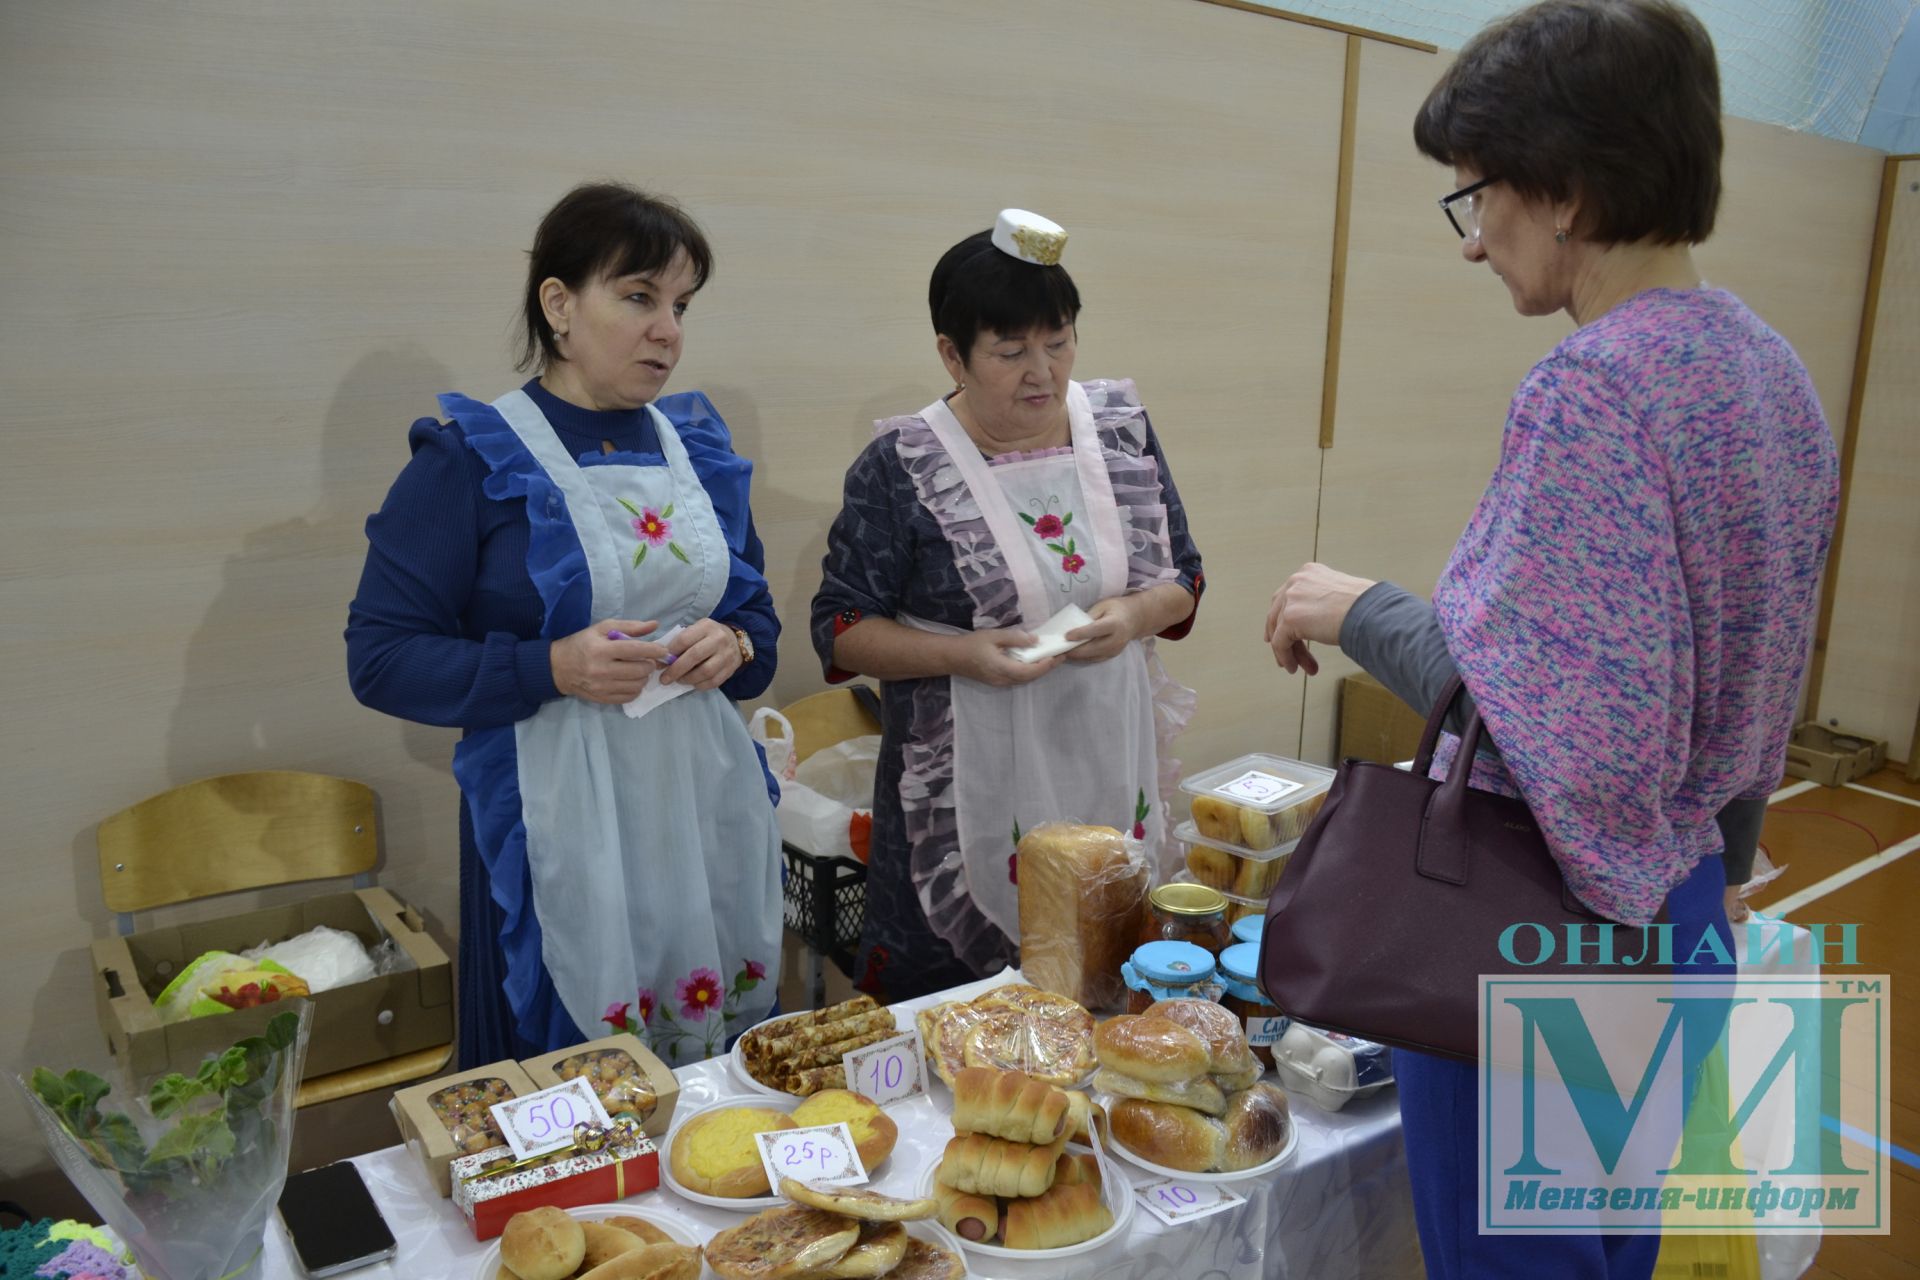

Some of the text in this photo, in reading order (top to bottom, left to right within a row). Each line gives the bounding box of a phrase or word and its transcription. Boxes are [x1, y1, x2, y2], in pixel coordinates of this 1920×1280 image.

[870, 1055, 902, 1096] 10
[529, 1096, 575, 1138] 50
[1157, 1185, 1198, 1209] 10
